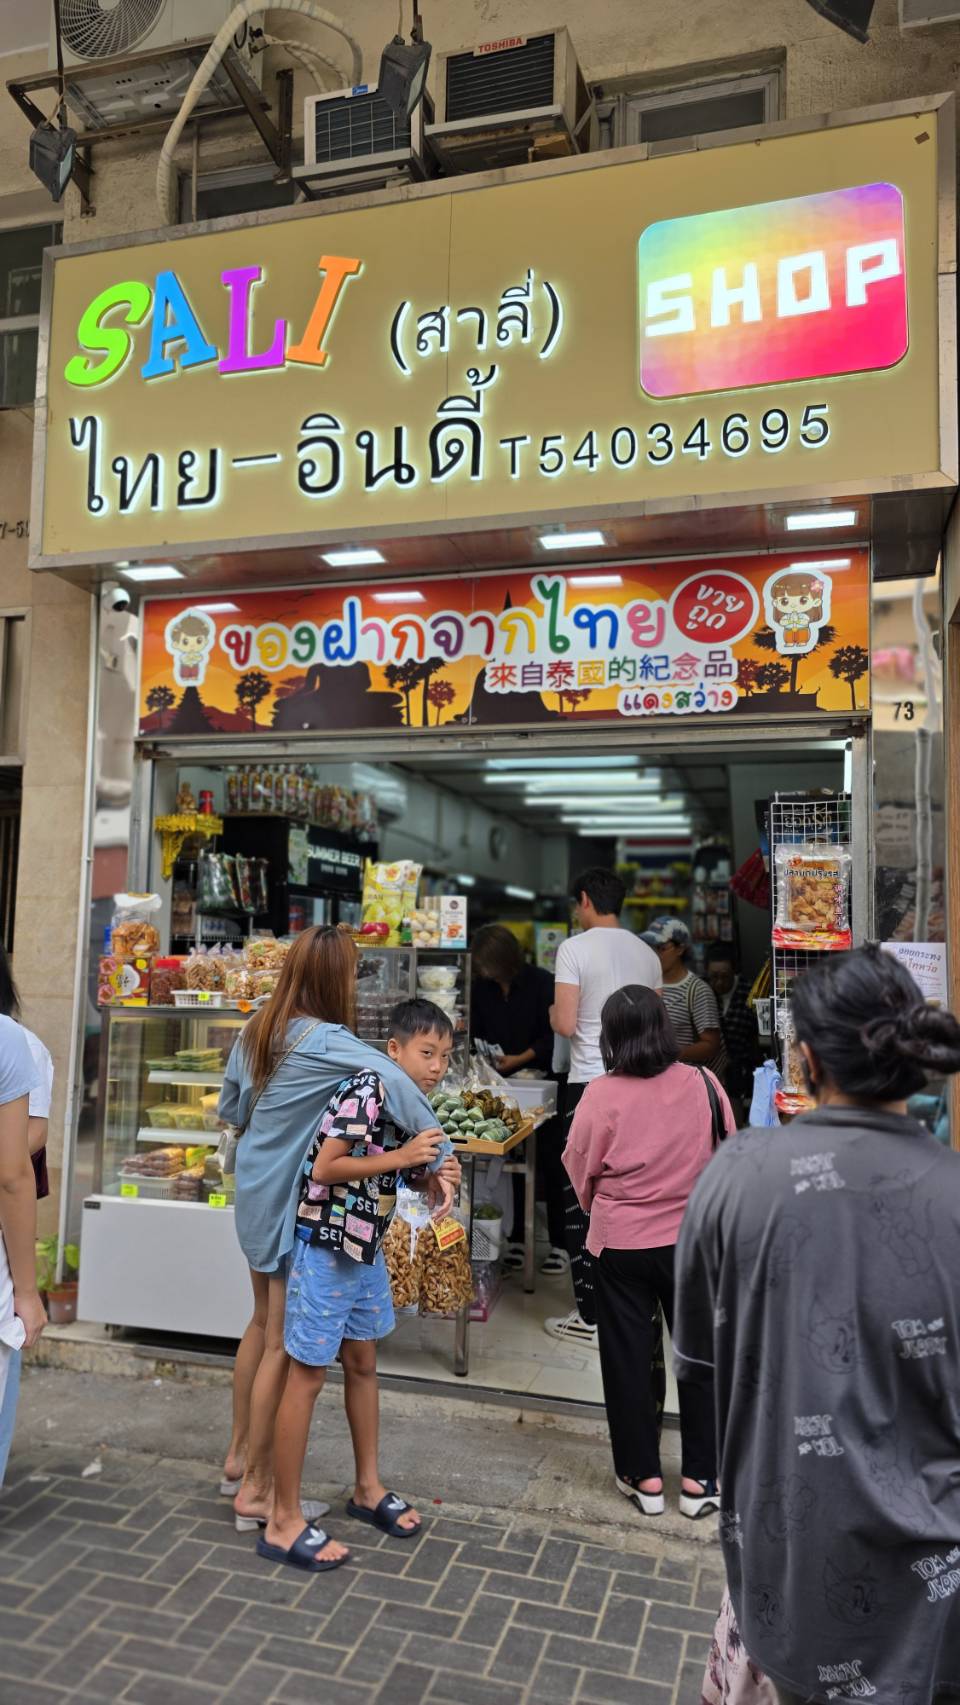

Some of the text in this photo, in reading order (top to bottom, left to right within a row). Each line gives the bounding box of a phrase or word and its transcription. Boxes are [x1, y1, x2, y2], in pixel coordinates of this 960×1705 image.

[478, 37, 523, 53] TOSHIBA
[644, 238, 902, 338] SHOP
[64, 255, 362, 386] SALI
[391, 269, 561, 373] (สาลี่)
[696, 583, 745, 612] ขาย
[224, 578, 666, 667] ของฝากจากไทย
[686, 605, 727, 630] ถูก
[488, 650, 733, 690] 來自泰國的紀念品
[623, 682, 733, 712] แดงสว่าง
[893, 701, 914, 720] 73
[911, 1554, 947, 1580] TOM
